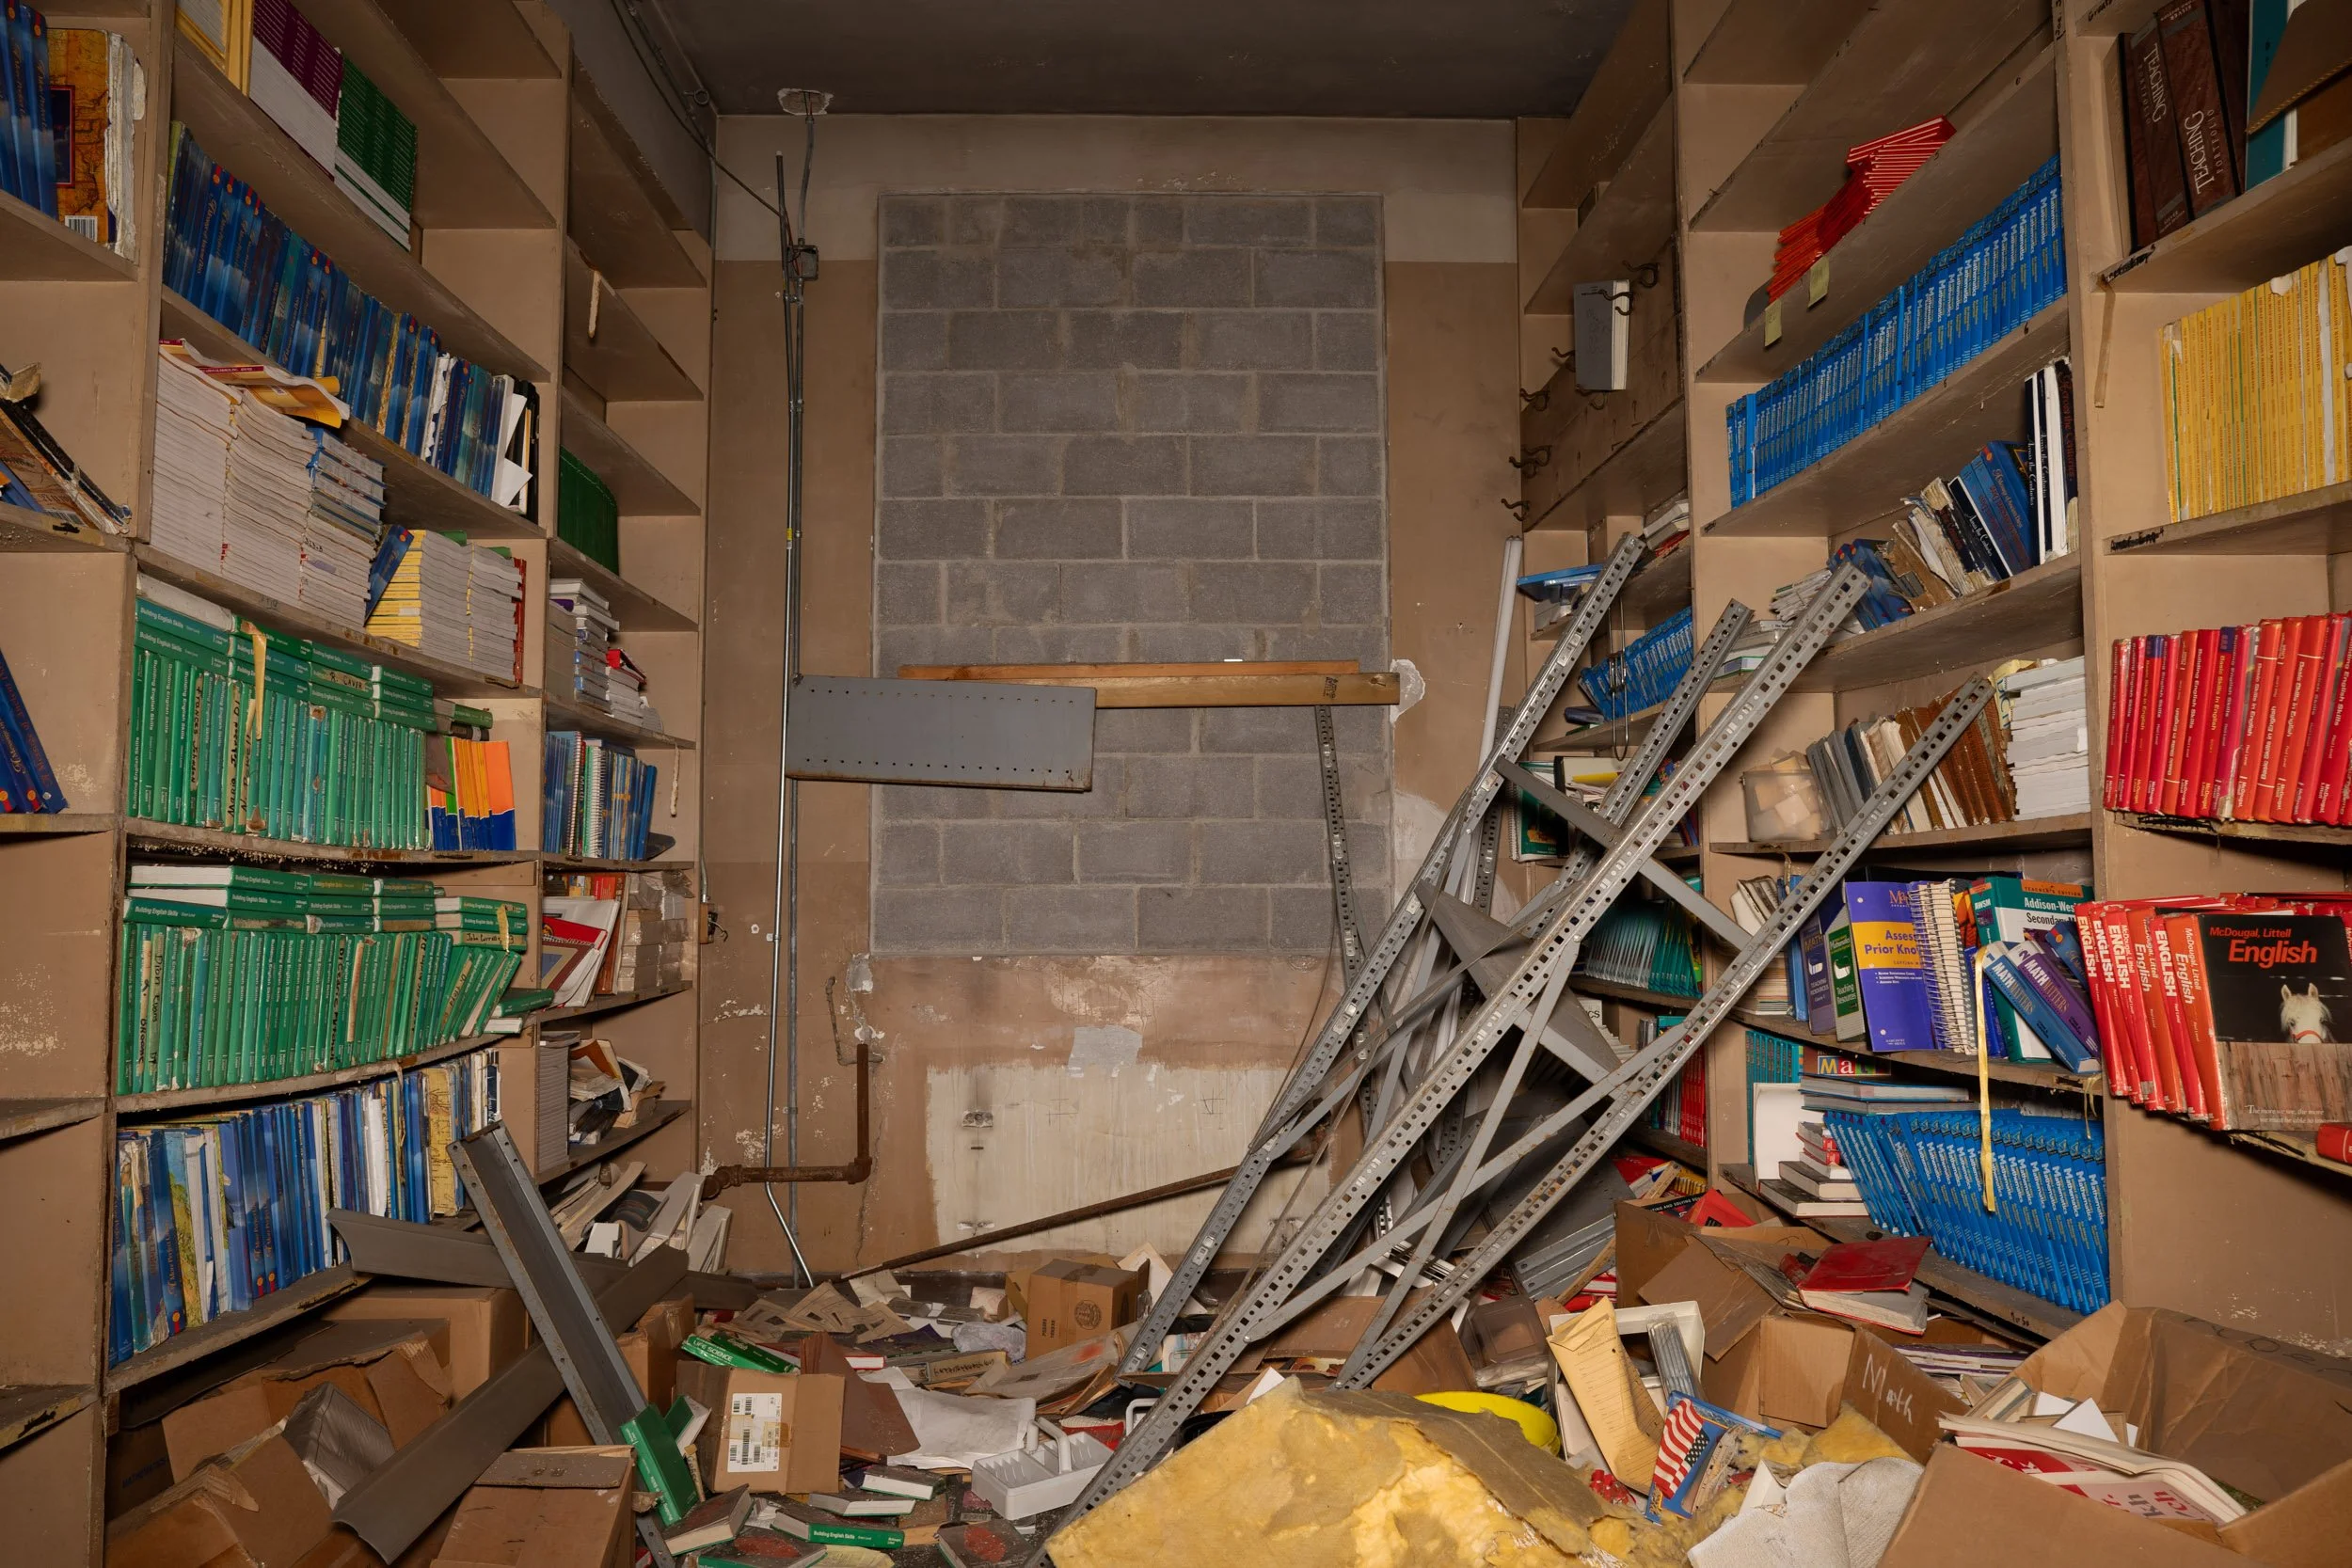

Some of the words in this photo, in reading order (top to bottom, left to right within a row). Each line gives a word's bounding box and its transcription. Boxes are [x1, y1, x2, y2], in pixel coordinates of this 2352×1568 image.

[2143, 43, 2168, 122] TEACHING
[2184, 110, 2213, 195] TEACHING
[2206, 109, 2224, 173] PORTFOLIO
[2018, 214, 2026, 261] Mathematics
[1962, 259, 1972, 304] Mathematics
[1970, 251, 1980, 297] Mathematics
[2194, 648, 2202, 679] Building
[135, 906, 151, 914] Building
[151, 908, 167, 916] English
[1975, 899, 1991, 910] AWSM
[2025, 897, 2075, 912] Addison-Wes
[1865, 943, 1894, 955] Prior
[2019, 950, 2030, 961] 2
[2078, 915, 2098, 978] ENGLISH
[2092, 919, 2115, 984] ENGLISH
[2210, 927, 2260, 938] McDougal,
[2264, 928, 2292, 937] Littell
[2229, 941, 2317, 969] English
[2108, 924, 2132, 990] ENGLISH
[2134, 942, 2153, 992] English
[2155, 929, 2178, 998] ENGLISH
[2175, 952, 2196, 1005] English
[2185, 927, 2198, 968] McDougal,
[2192, 968, 2201, 990] Littell
[1836, 984, 1853, 993] Teaching
[1915, 1141, 1932, 1181] Mathematics
[1946, 1145, 1963, 1187] Mathematics
[1957, 1147, 1974, 1190] Mathematics
[1997, 1154, 2014, 1200] Mathematics
[2018, 1159, 2034, 1206] Mathematics
[2030, 1162, 2048, 1209] Mathematics
[2041, 1163, 2059, 1212] Mathematics
[2052, 1165, 2069, 1215] Mathematics
[2063, 1167, 2082, 1217] Mathematics
[2075, 1171, 2095, 1221] Mathematics
[692, 1340, 707, 1350] LIFE
[707, 1346, 734, 1362] SCIENCE
